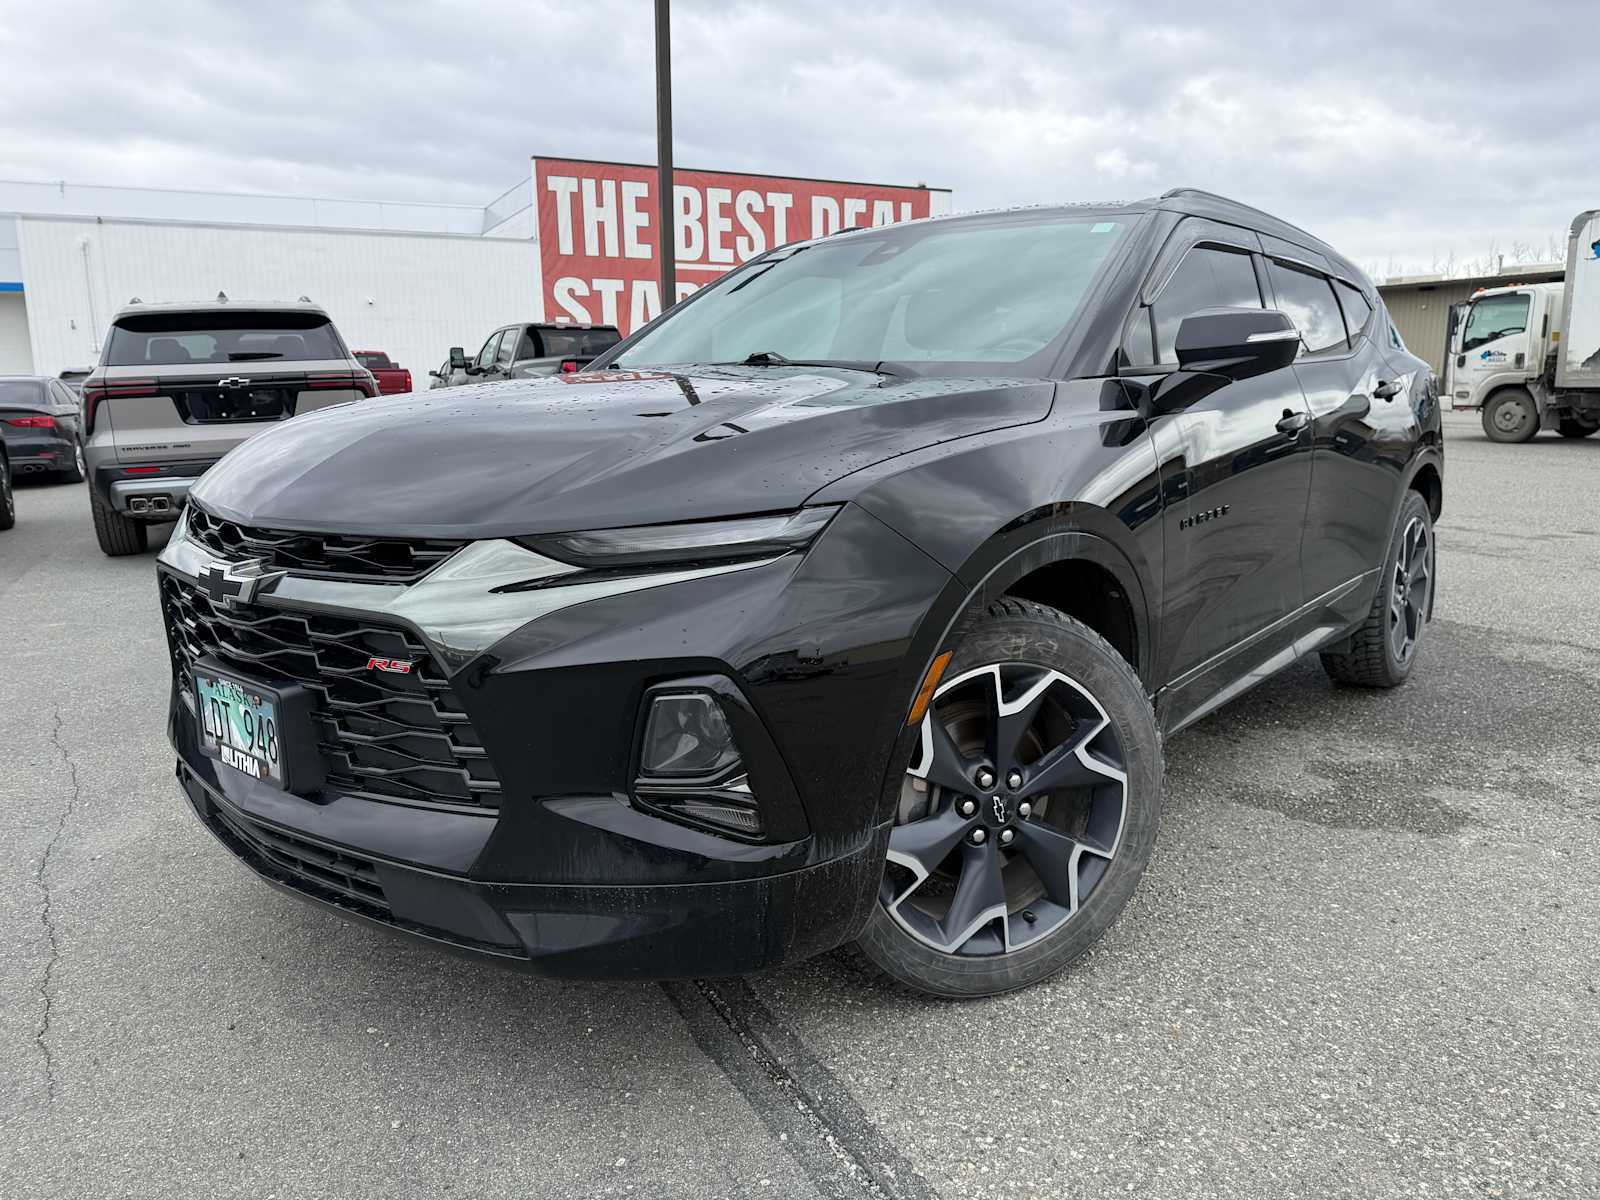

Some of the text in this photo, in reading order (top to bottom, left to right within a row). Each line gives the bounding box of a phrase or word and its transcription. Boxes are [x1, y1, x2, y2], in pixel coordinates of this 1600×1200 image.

[546, 175, 653, 260] THE
[672, 184, 793, 263] BEST
[366, 656, 412, 674] RS
[200, 692, 278, 765] LDT 948
[228, 747, 261, 779] LITHIA
